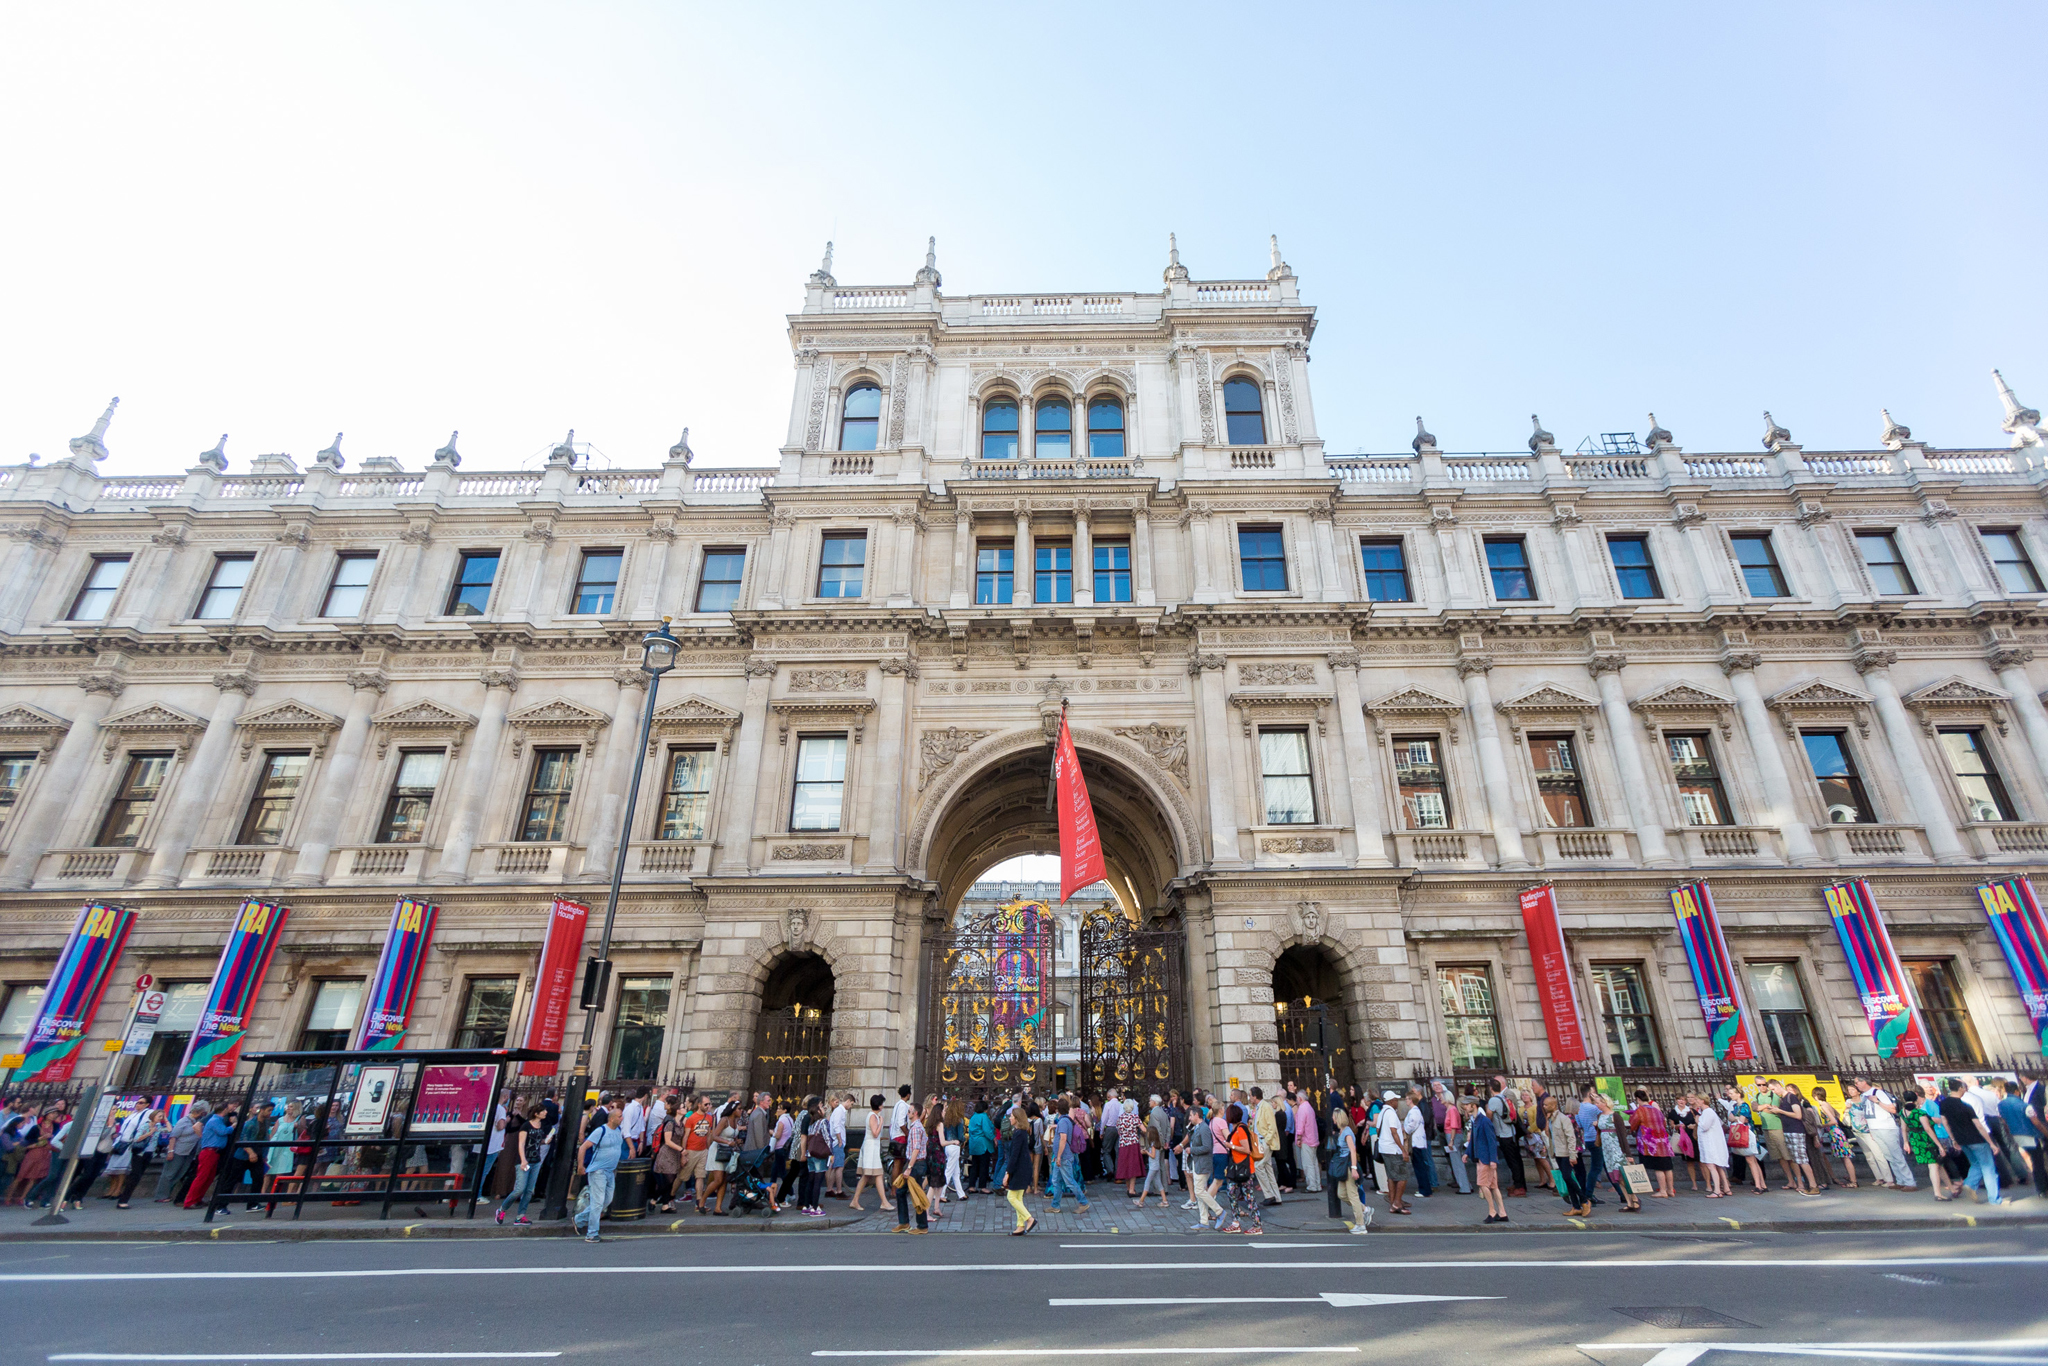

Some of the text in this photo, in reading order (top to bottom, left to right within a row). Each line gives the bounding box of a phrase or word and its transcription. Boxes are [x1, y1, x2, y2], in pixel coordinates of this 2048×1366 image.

[1520, 890, 1546, 903] Burlington
[1824, 886, 1857, 918] RA
[1978, 885, 2017, 915] RA
[558, 902, 585, 916] Burlington
[1522, 900, 1539, 910] House
[1671, 889, 1698, 920] RA
[237, 903, 270, 935] RA
[396, 902, 424, 933] RA
[557, 909, 575, 920] House
[80, 907, 117, 939] RA
[141, 976, 148, 987] L
[1700, 996, 1731, 1006] Discover
[1862, 994, 1900, 1004] Discover
[1702, 1005, 1737, 1015] The New.
[1864, 1003, 1906, 1014] The New.
[40, 1016, 84, 1028] Discover
[204, 1011, 243, 1024] Discover
[372, 1011, 406, 1023] Discover
[37, 1025, 81, 1037] The New.
[201, 1020, 241, 1032] The New.
[370, 1020, 385, 1030] The
[116, 1100, 136, 1109] over
